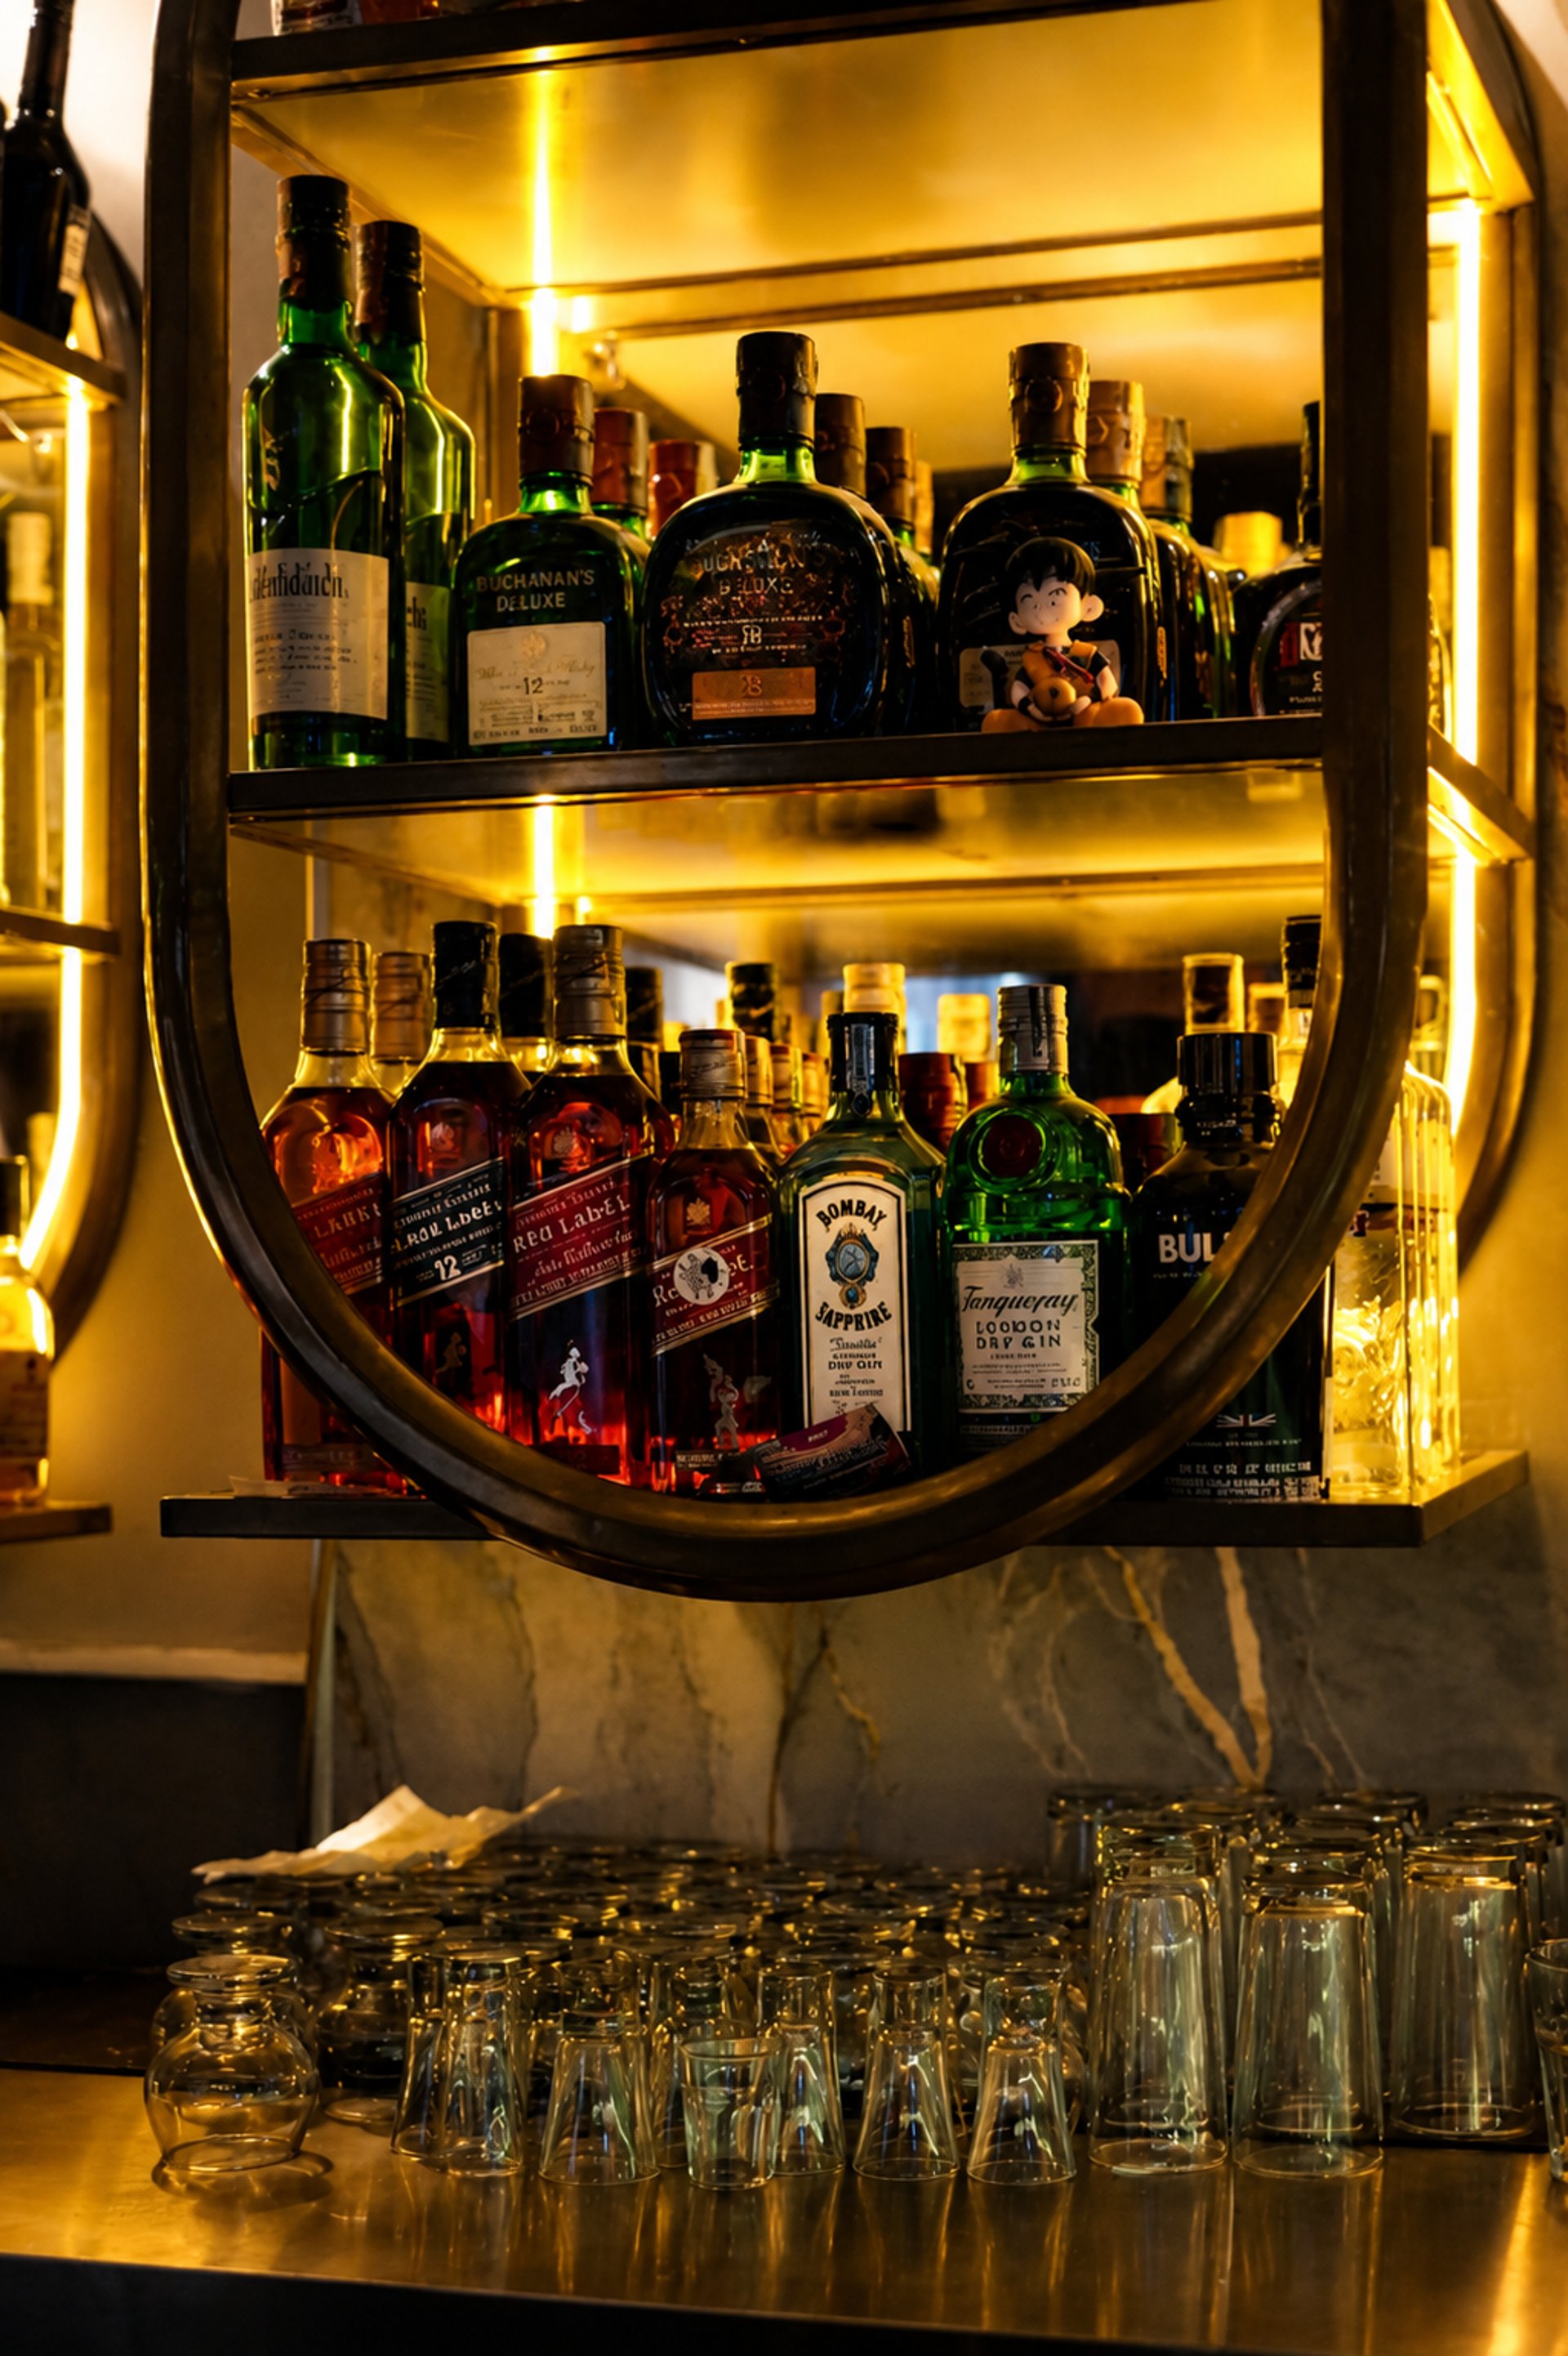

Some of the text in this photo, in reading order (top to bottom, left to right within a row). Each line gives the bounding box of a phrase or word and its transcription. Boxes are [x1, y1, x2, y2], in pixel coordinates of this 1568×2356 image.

[476, 569, 595, 592] BUCHANAN'S
[497, 592, 566, 612] DELUXE
[523, 676, 544, 694] 12
[815, 1198, 888, 1230] BOMBAY
[1158, 1232, 1231, 1264] BUL
[434, 1253, 462, 1282] 12
[962, 1285, 1079, 1318] Tanqueray
[976, 1319, 1060, 1334] LONDON
[976, 1335, 1062, 1350] DRY GIN
